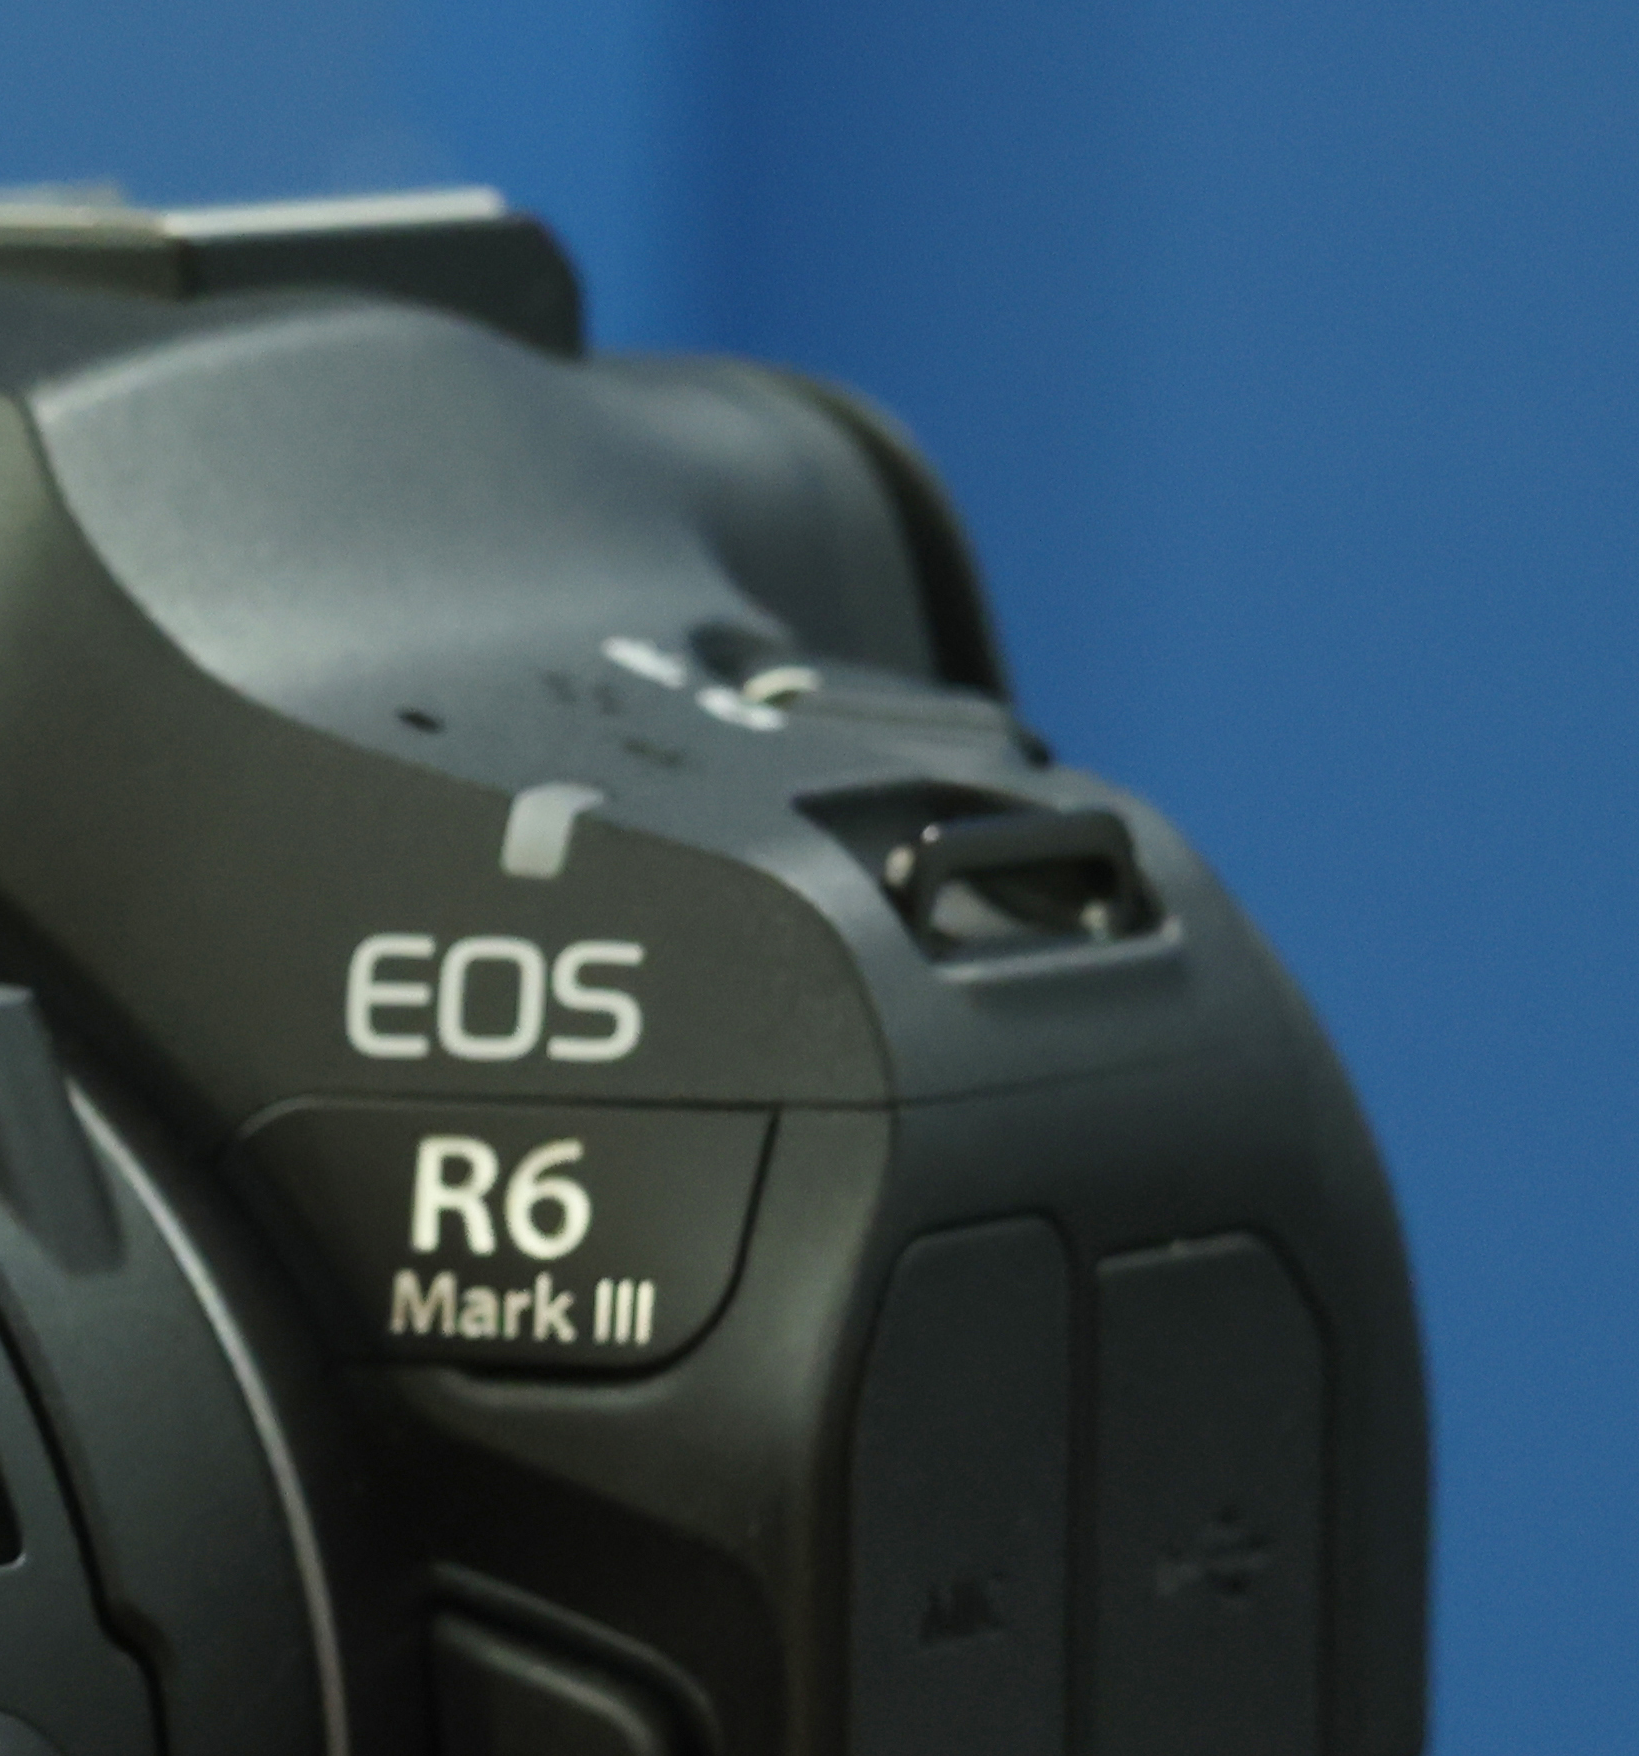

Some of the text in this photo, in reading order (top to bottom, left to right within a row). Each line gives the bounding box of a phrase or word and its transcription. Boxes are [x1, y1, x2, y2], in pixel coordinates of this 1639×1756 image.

[344, 932, 645, 1063] EOS
[410, 1134, 592, 1261] R6
[388, 1269, 656, 1347] Mark III
